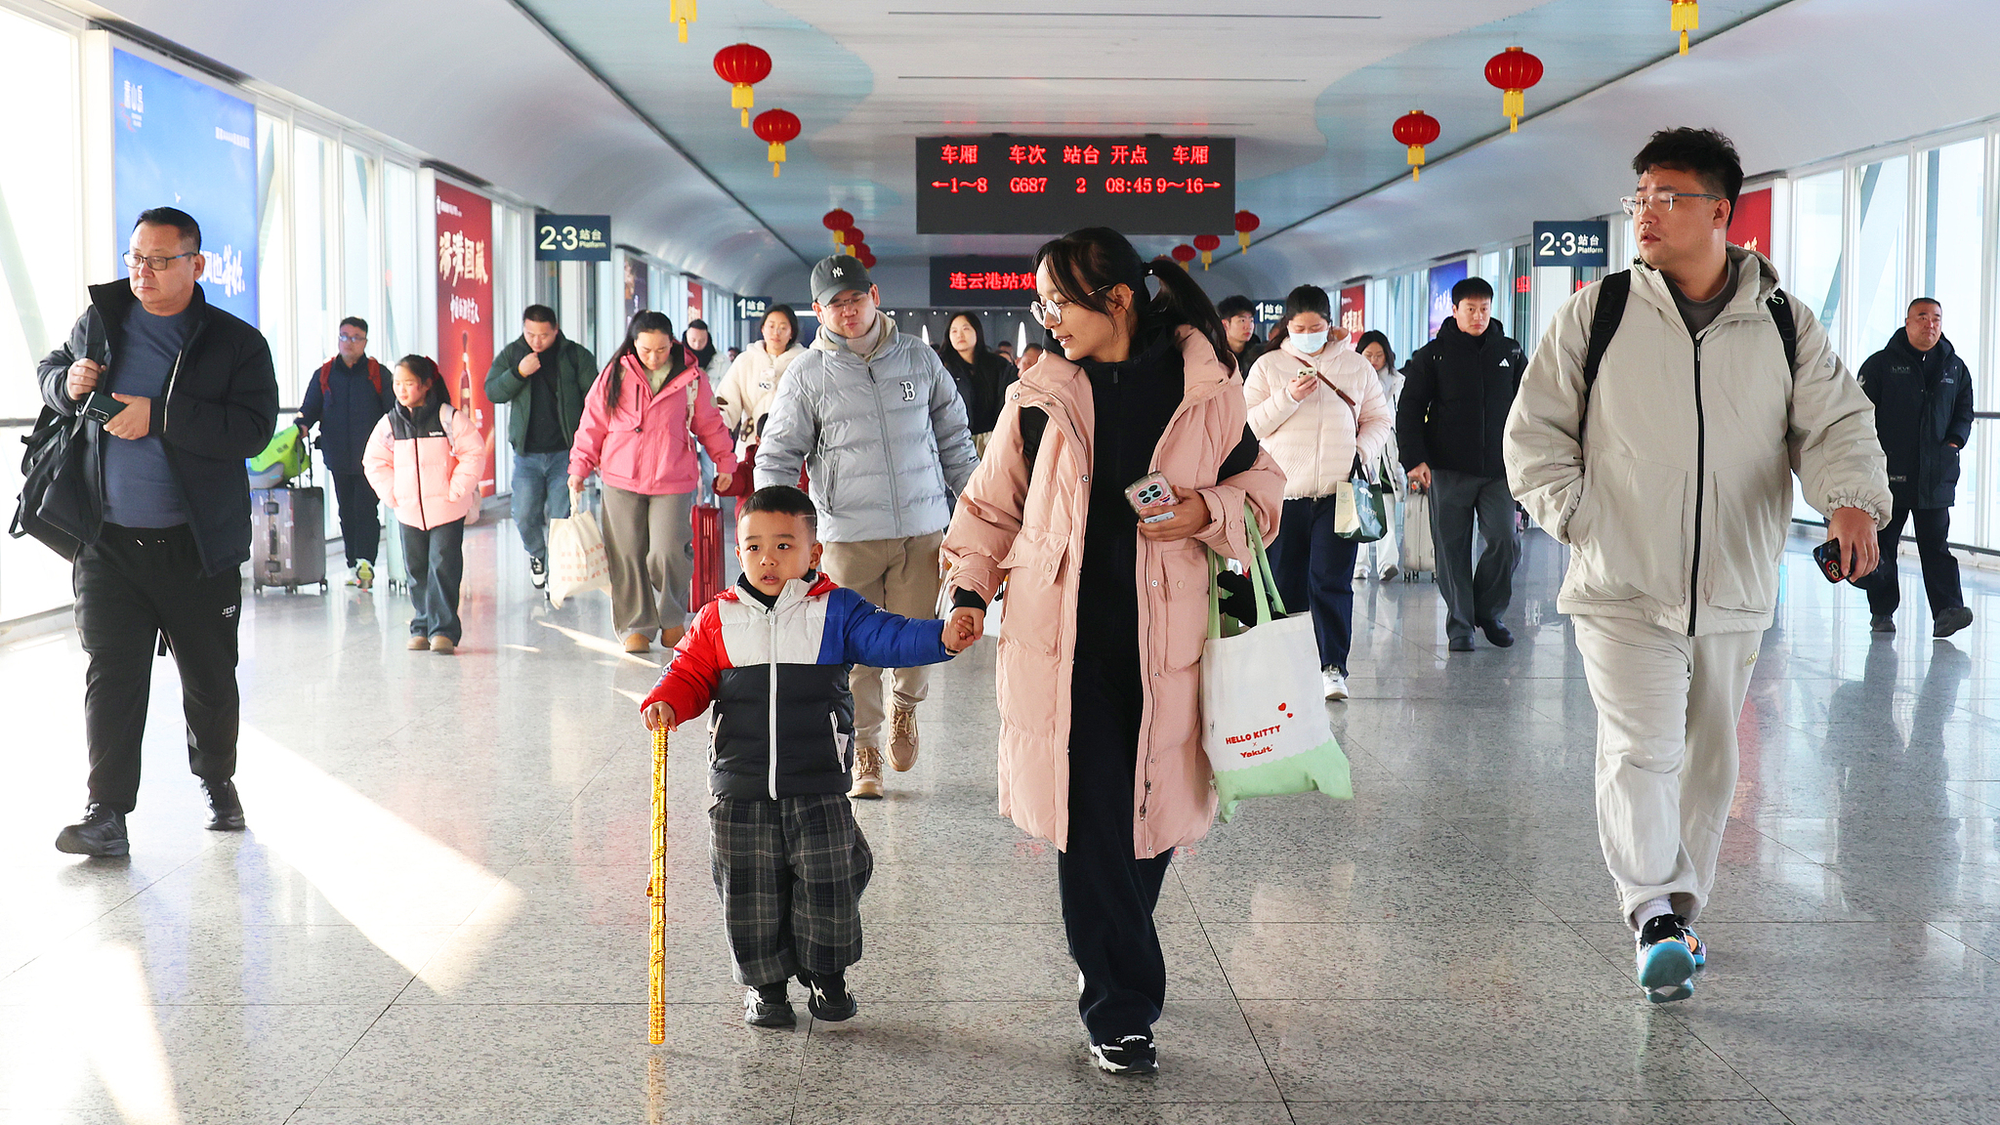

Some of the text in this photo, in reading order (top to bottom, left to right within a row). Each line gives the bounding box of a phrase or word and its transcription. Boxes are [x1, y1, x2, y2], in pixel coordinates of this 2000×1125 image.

[940, 144, 1210, 165] 车厢 车次 站台 开点 车厢
[1009, 177, 1048, 193] G687
[1075, 177, 1087, 194] 2
[1105, 177, 1153, 194] 08:45
[579, 228, 602, 240] 站台
[1578, 234, 1599, 246] 站台
[579, 240, 606, 248] Platform
[1578, 246, 1603, 254] Platform
[949, 271, 1036, 291] 连云港站欢
[737, 298, 766, 319] 1 站台
[1256, 302, 1283, 322] 1 站台
[900, 381, 916, 401] B
[1225, 725, 1281, 745] HELLO KITTY
[1240, 747, 1273, 758] Yakult
